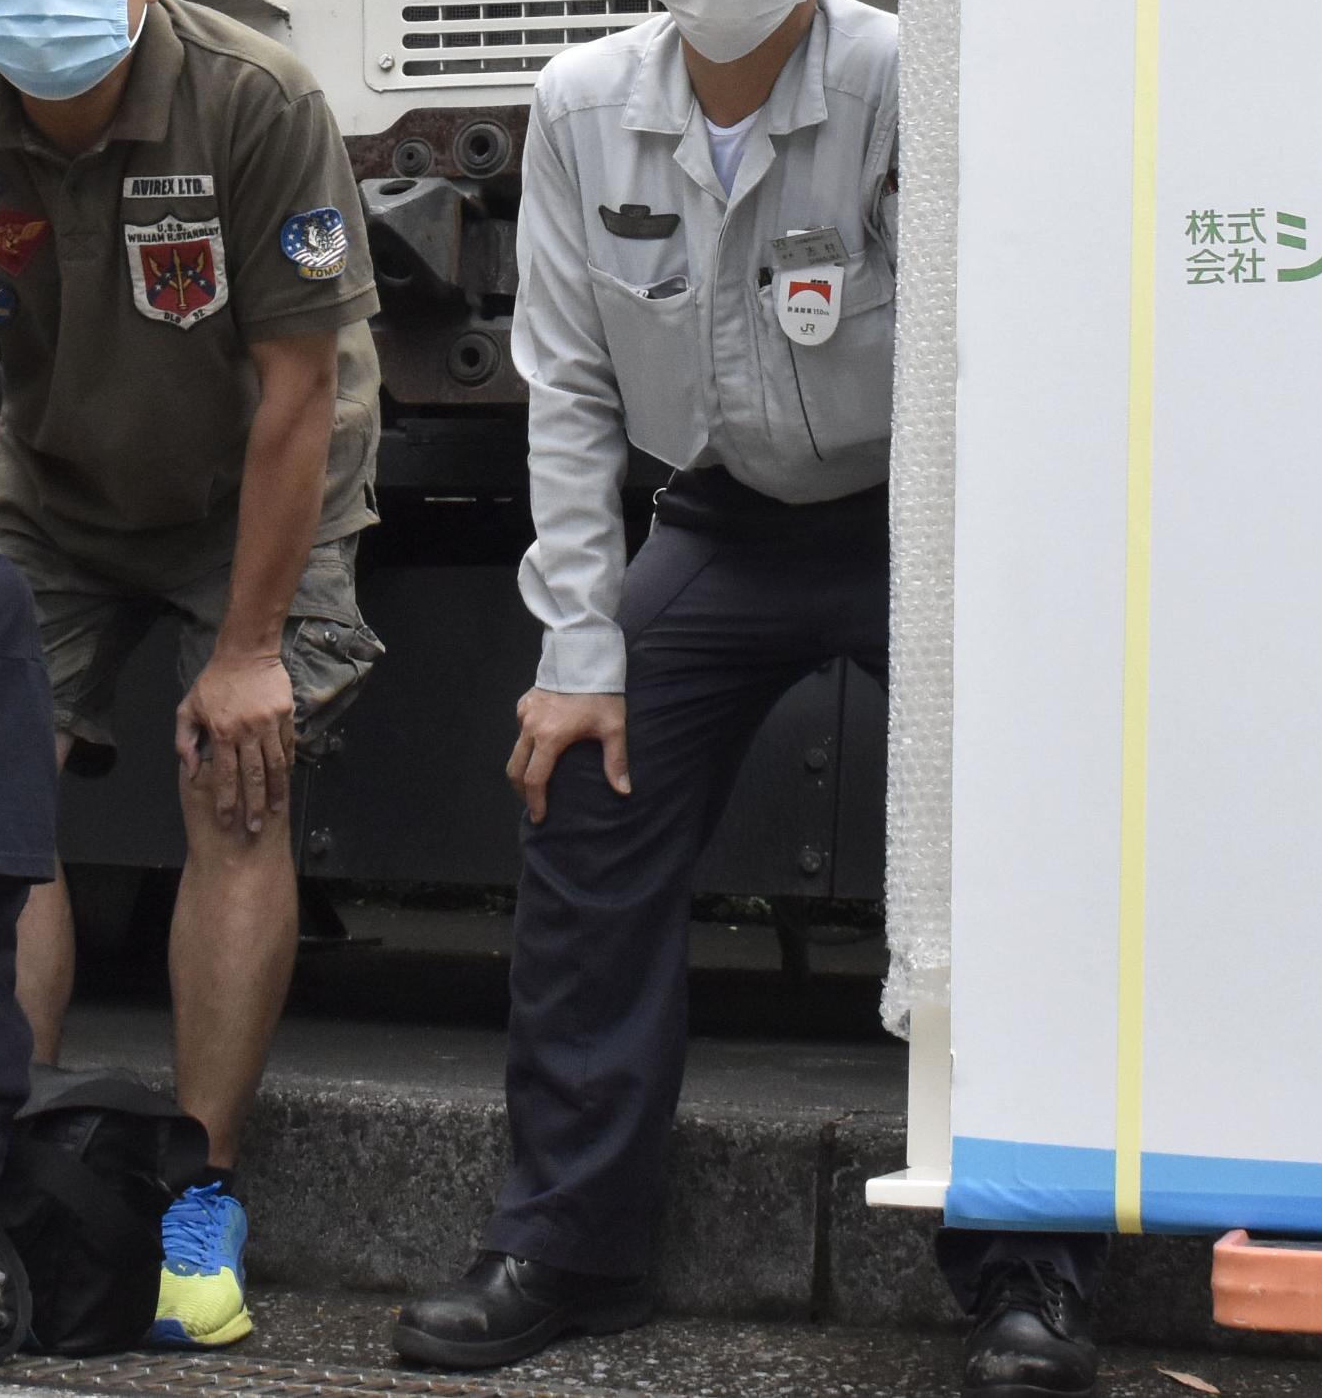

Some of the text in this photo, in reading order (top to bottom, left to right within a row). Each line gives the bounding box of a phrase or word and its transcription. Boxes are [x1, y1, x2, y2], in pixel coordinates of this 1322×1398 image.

[131, 177, 206, 196] AVIREX LTD.
[1185, 208, 1267, 247] 株式
[128, 232, 166, 244] WILLIAM
[1185, 249, 1267, 286] 会社
[800, 323, 815, 333] JR
